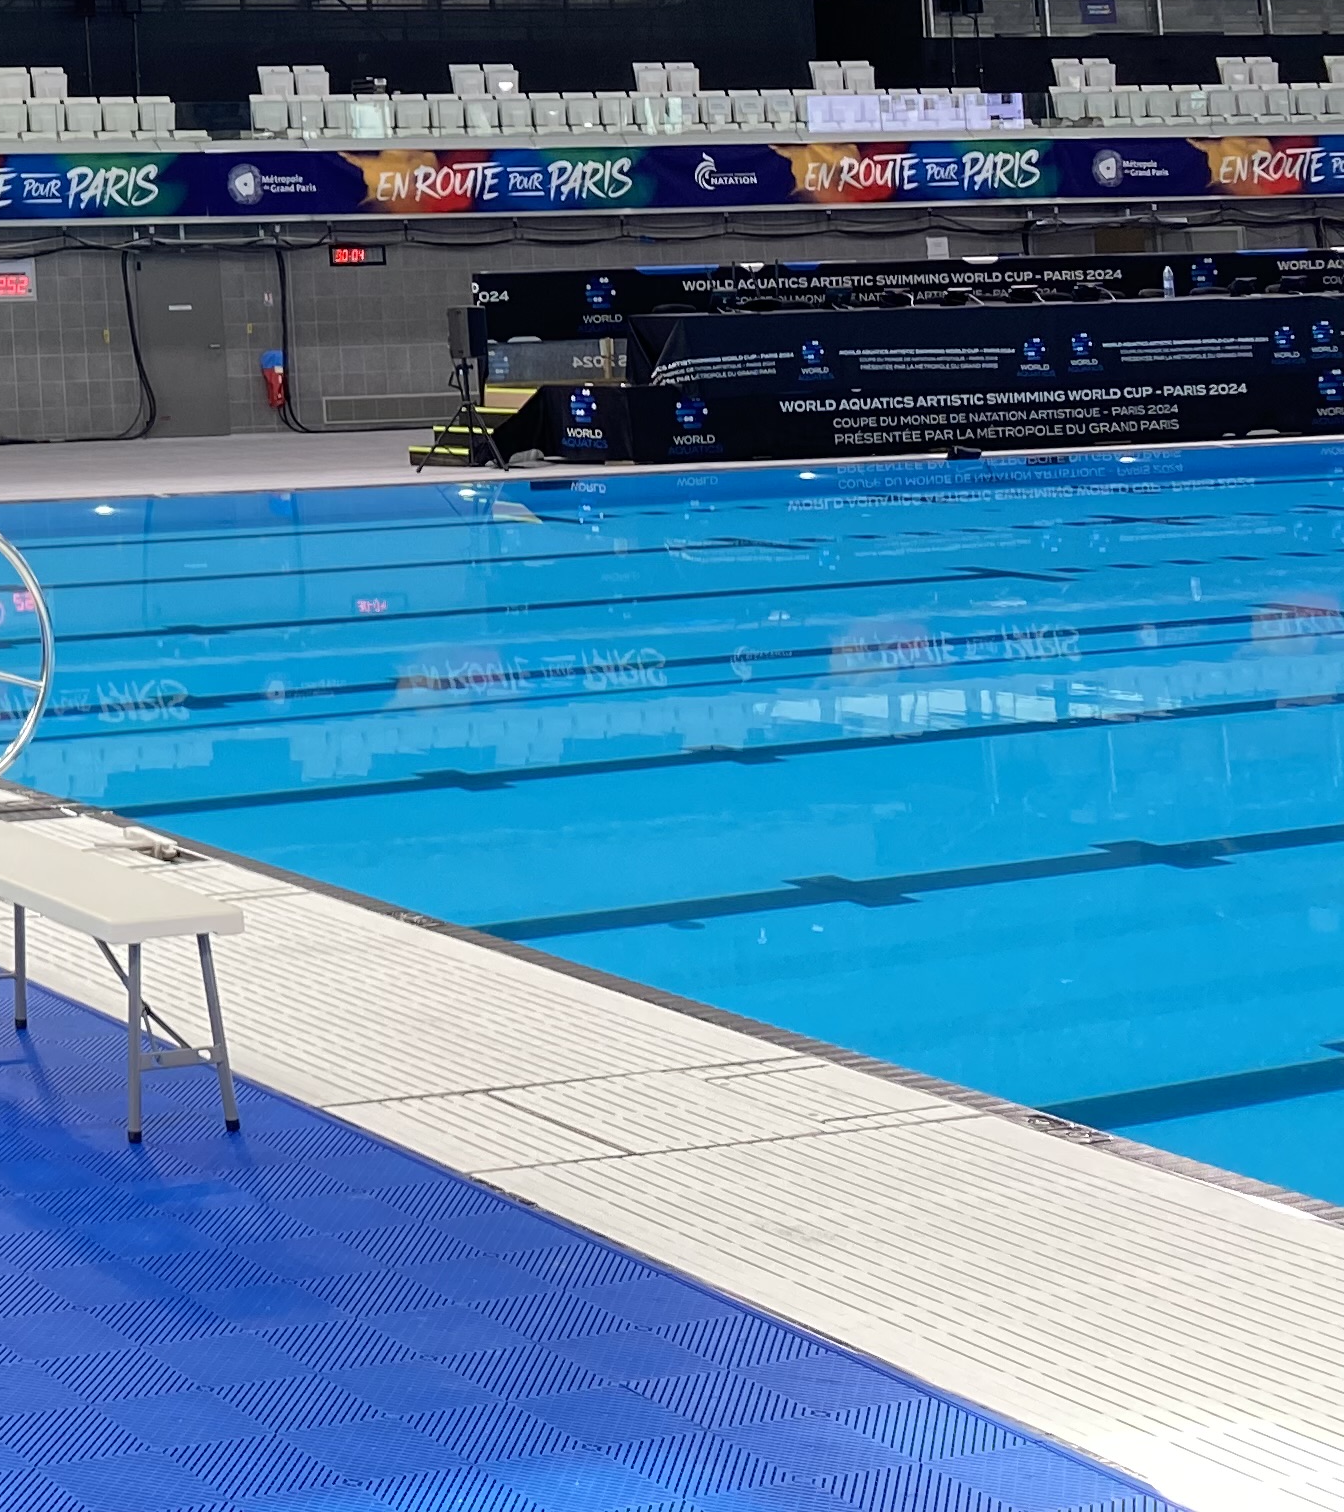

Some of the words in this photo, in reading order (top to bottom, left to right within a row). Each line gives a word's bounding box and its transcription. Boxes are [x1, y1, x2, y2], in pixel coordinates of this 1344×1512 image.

[804, 160, 837, 192] EN
[838, 152, 920, 192] ROUTE
[926, 162, 959, 181] POUR
[962, 149, 1041, 192] PARIS
[1219, 155, 1250, 184] EN
[1252, 148, 1328, 183] ROUTE
[261, 174, 304, 186] Métropole
[377, 170, 411, 201] EN
[413, 161, 504, 202] ROUTE
[509, 172, 544, 191] POUR
[547, 157, 634, 202] PARIS
[712, 175, 758, 185] NATATION
[22, 178, 61, 198] POUR
[66, 163, 160, 210] PARIS
[270, 183, 295, 192] Grand
[296, 182, 317, 193] Paris
[1277, 260, 1325, 271] WORLD
[811, 275, 873, 289] ARTISTIC
[876, 273, 949, 287] SWIMMING
[951, 272, 1002, 284] WORLD
[1005, 271, 1032, 283] CUP
[1043, 269, 1085, 281] PARIS
[1086, 268, 1123, 280] 2024
[583, 314, 623, 324] WORLD
[1273, 350, 1301, 359] WORLD
[1311, 345, 1338, 353] WORLD
[1020, 363, 1050, 371] WORLD
[1069, 358, 1099, 366] WORLD
[800, 366, 830, 375] WORLD
[779, 398, 836, 413] WORLD
[838, 395, 914, 411] AQUATICS
[915, 392, 984, 408] ARTISTIC
[986, 389, 1066, 405] SWIMMING
[1067, 387, 1121, 402] WORLD
[1123, 385, 1152, 399] CUP
[1163, 384, 1207, 398] PARIS
[1209, 382, 1248, 396] 2024
[833, 416, 877, 429] COUPE
[879, 415, 898, 427] DU
[900, 413, 947, 426] MONDE
[949, 411, 967, 424] DE
[969, 409, 1027, 423] NATATION
[1029, 406, 1101, 420] ARTISTIQUE
[1111, 404, 1146, 417] PARIS
[1147, 403, 1179, 415] 2024
[566, 427, 604, 439] WORLD
[834, 428, 922, 445] PRÉSENTÉE
[924, 428, 954, 441] PAR
[955, 427, 974, 440] LA
[976, 423, 1063, 439] MÉTROPOLE
[1065, 422, 1086, 435] DU
[1088, 420, 1138, 434] GRAND
[1139, 418, 1180, 431] PARIS
[561, 437, 608, 449] AQUATICS
[673, 434, 716, 446] WORLD
